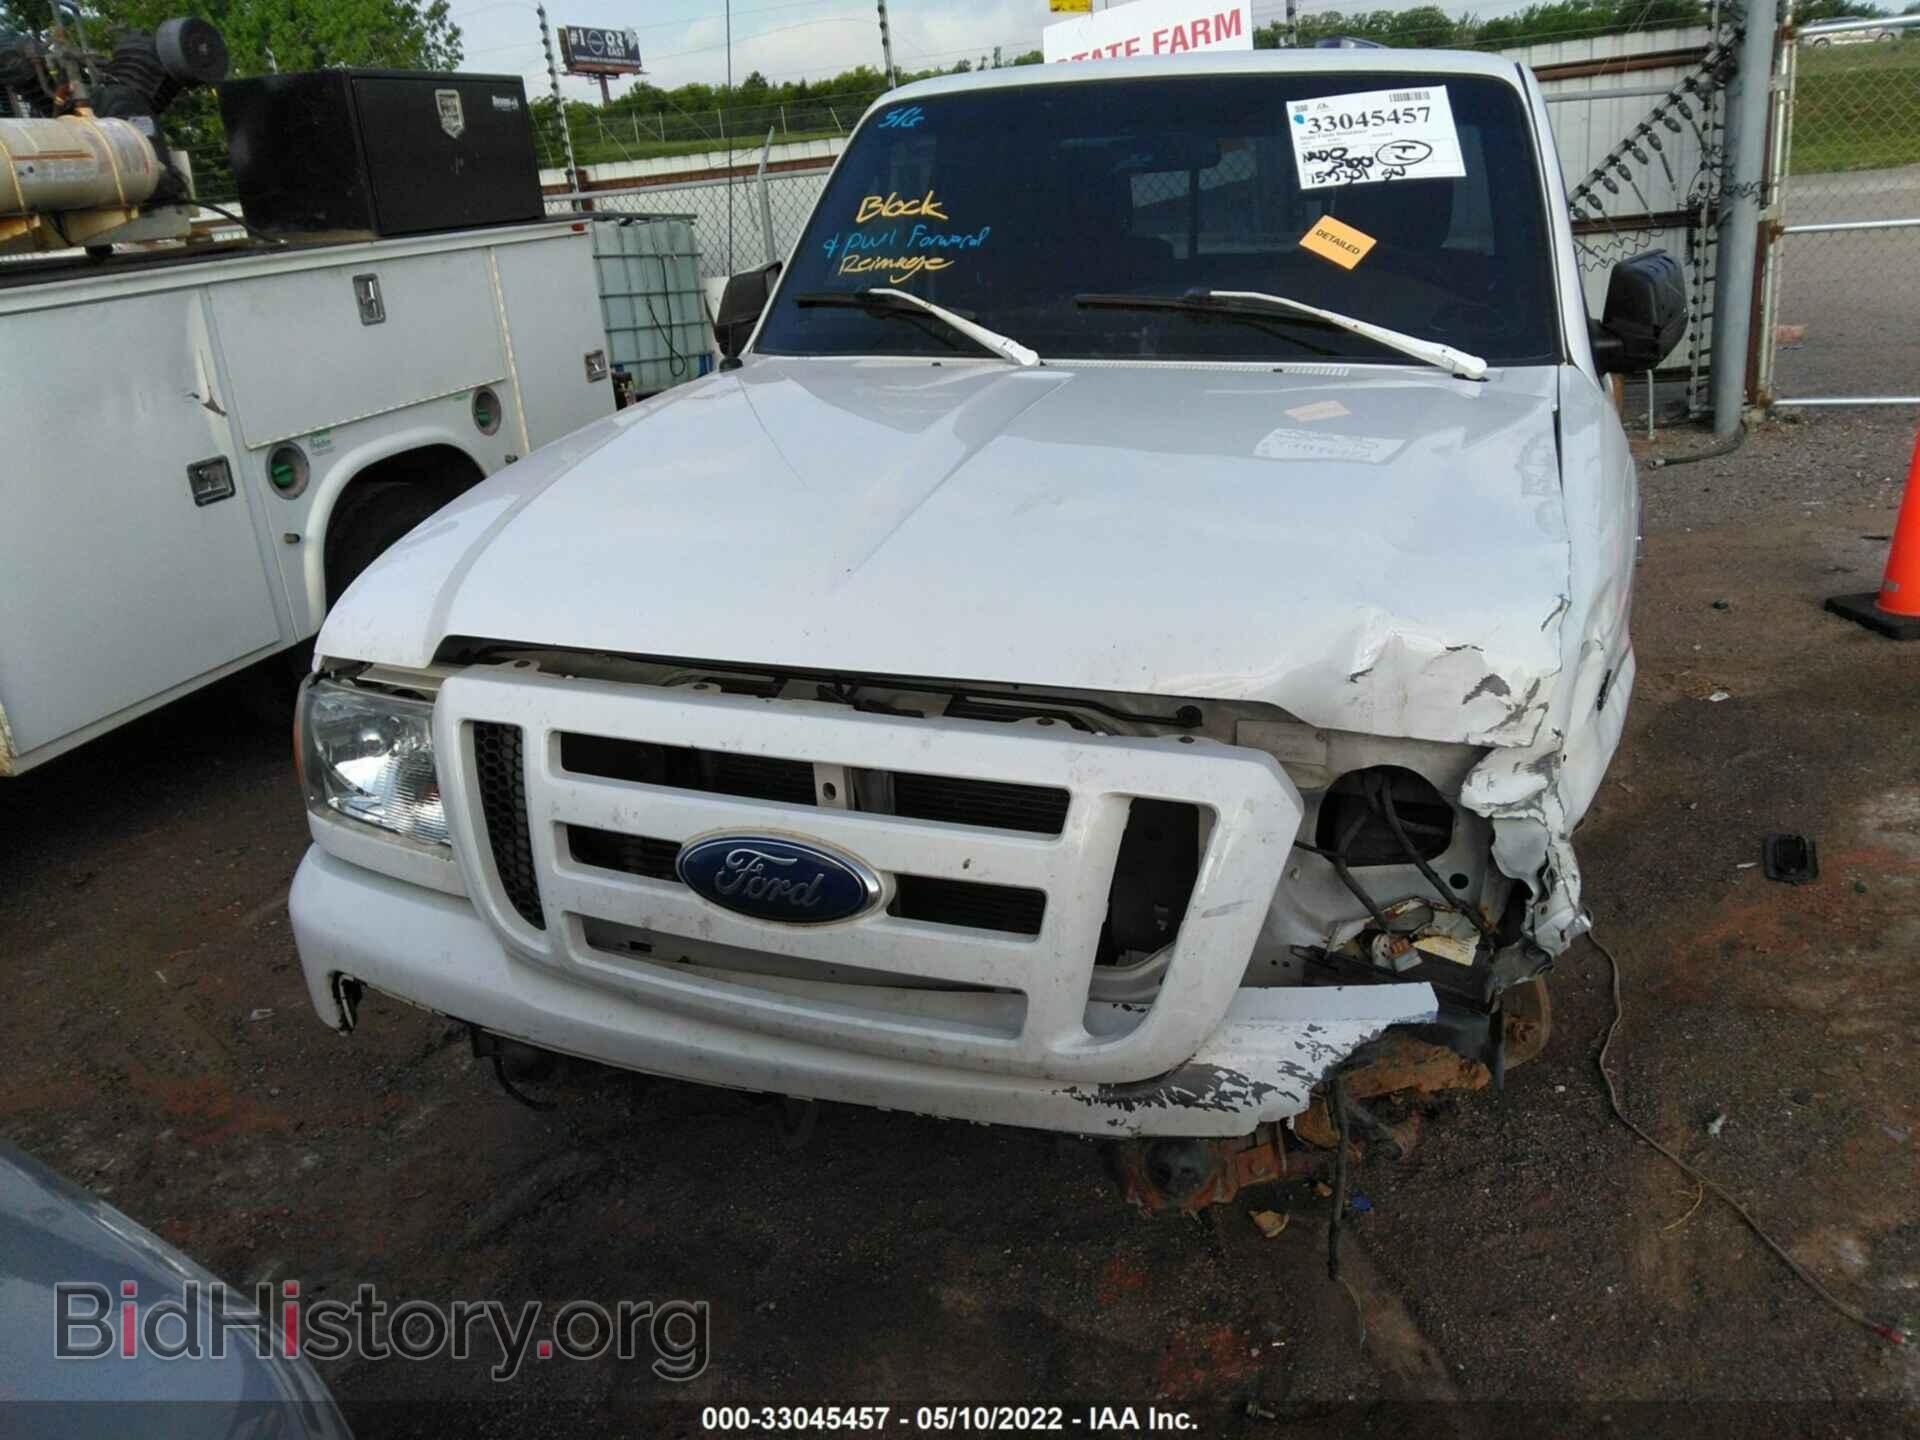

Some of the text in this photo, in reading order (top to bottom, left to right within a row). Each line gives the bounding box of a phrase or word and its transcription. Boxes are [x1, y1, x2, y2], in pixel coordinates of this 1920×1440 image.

[1152, 8, 1242, 56] FARM
[1307, 105, 1431, 135] 33045457
[856, 190, 949, 223] Block
[1315, 228, 1361, 255] DETAILED
[713, 848, 825, 907] Ford
